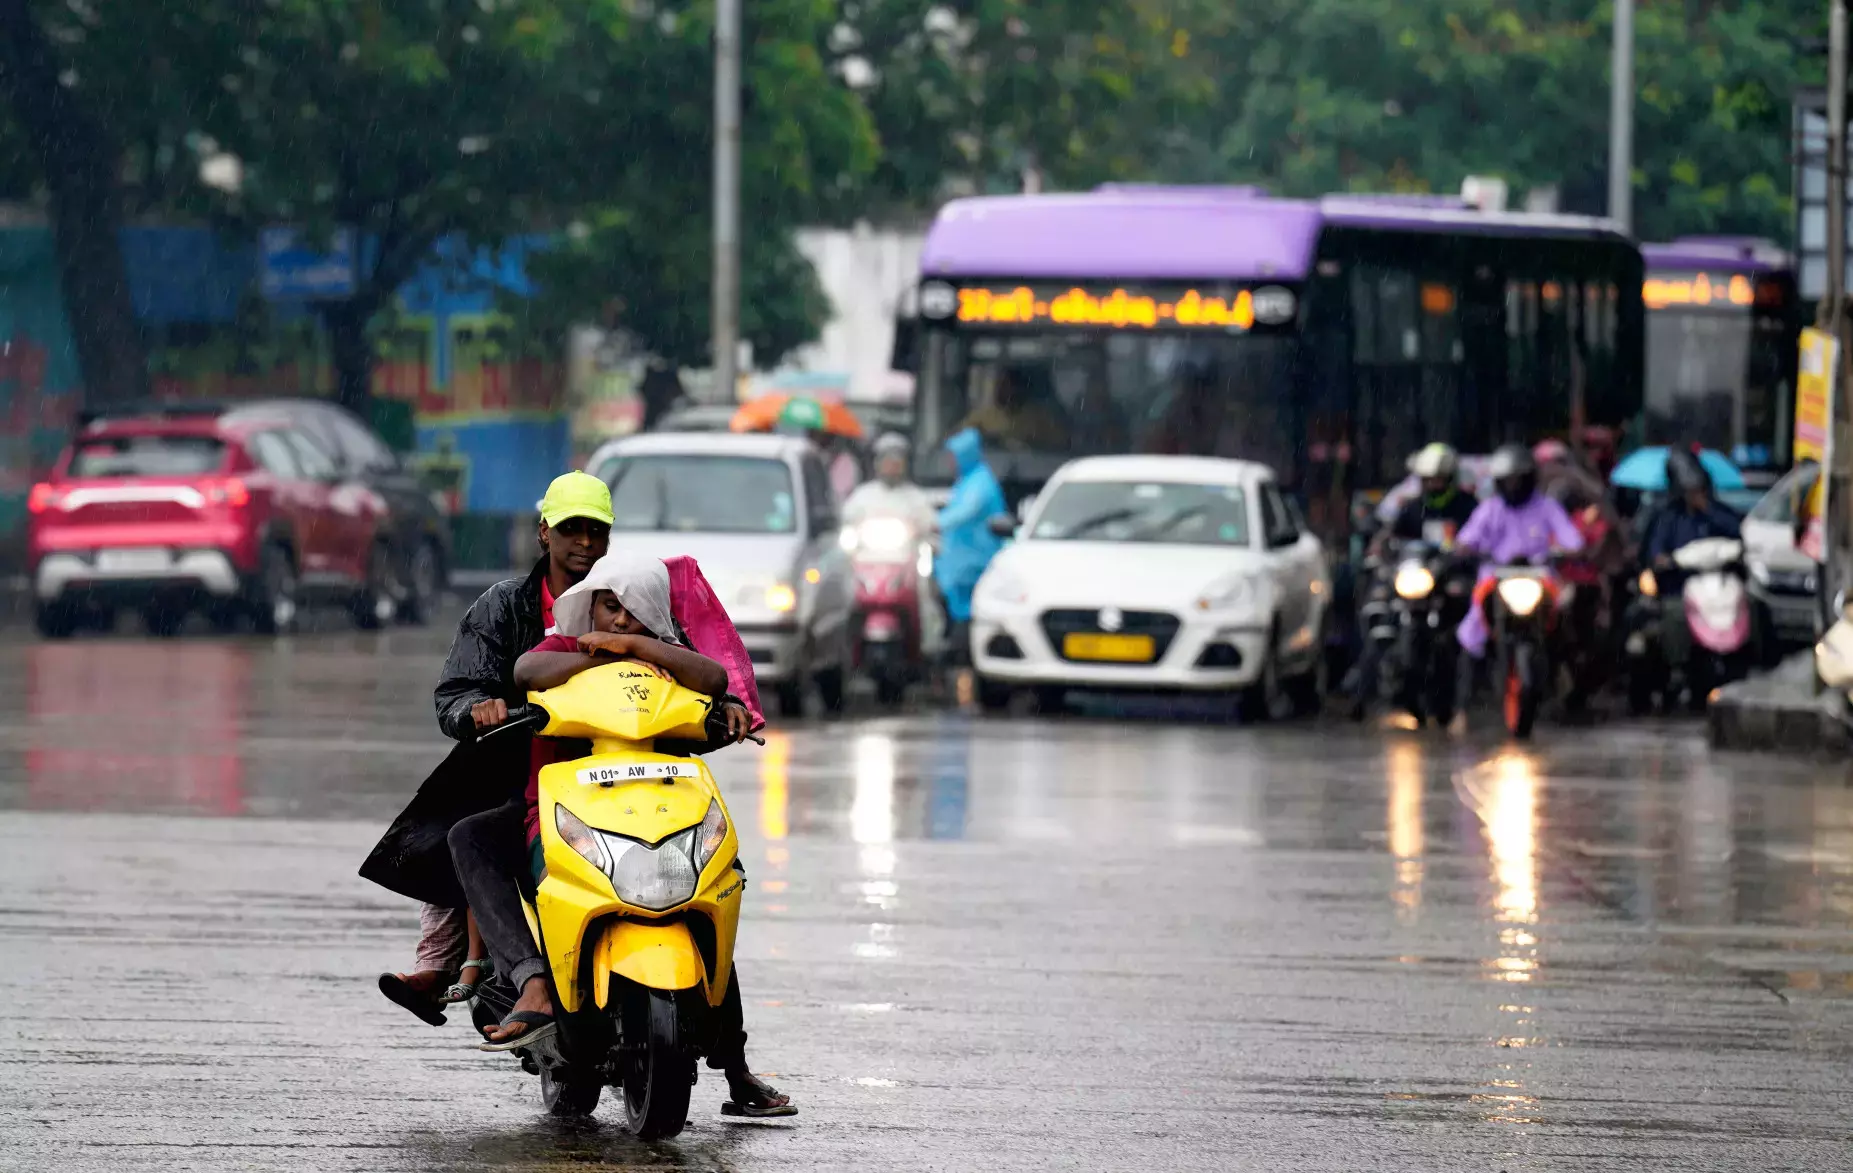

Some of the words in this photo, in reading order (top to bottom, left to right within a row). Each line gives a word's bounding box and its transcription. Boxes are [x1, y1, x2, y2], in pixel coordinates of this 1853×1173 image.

[600, 769, 614, 780] 01
[628, 766, 645, 777] AW
[665, 765, 679, 776] 10
